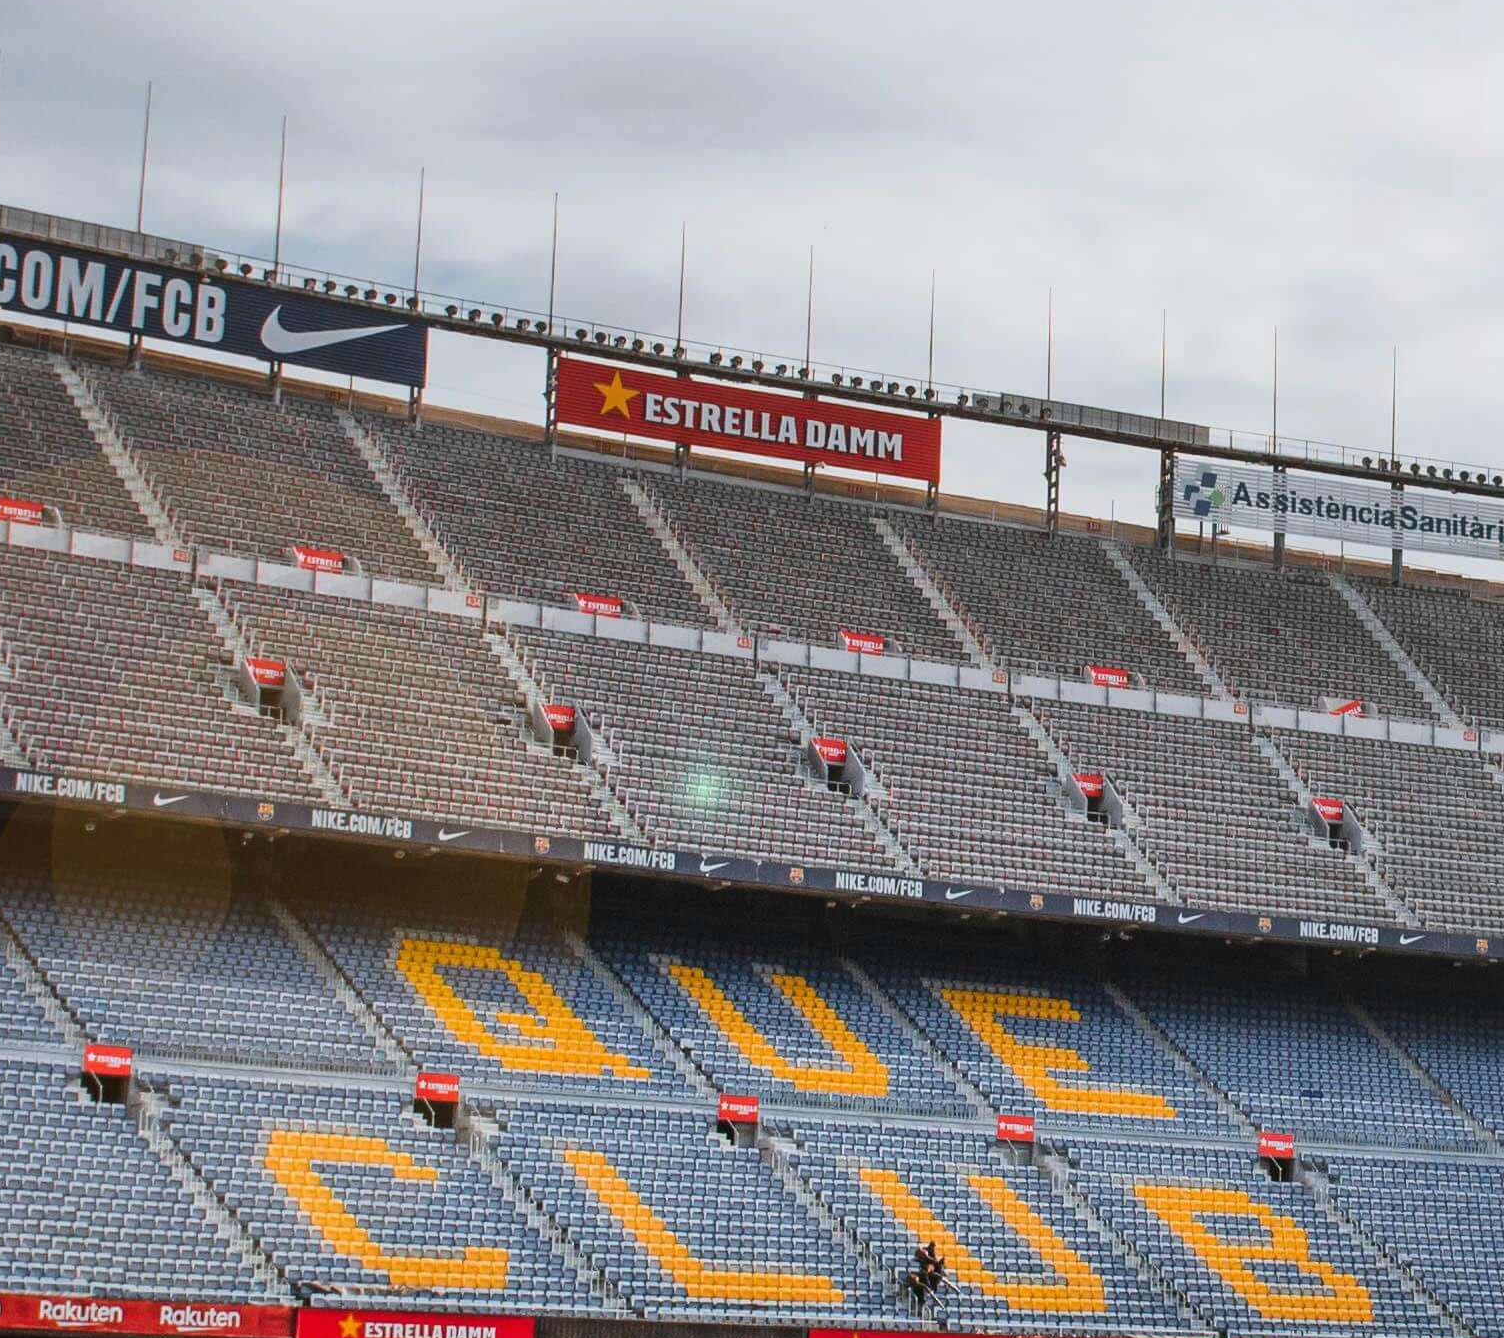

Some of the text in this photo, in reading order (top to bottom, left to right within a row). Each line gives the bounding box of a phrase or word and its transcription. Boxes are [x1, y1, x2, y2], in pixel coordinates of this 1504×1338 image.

[645, 393, 903, 461] ESTRELLA DAMM
[4, 507, 42, 519] ESTRELLA
[1232, 482, 1396, 528] Assistència
[16, 772, 125, 804] NIKE.COM/FCB
[312, 809, 412, 839] NIKE.COM/FCB
[583, 842, 675, 870] NIKE.COM/FCB
[835, 871, 923, 898] NIKE.COM/FCB
[1073, 898, 1156, 922] NIKE.COM/FCB
[1300, 921, 1379, 944] NIKE.COM/FCB
[396, 938, 1176, 1118] QUE
[263, 1130, 1375, 1322] CLUB
[39, 1300, 122, 1323] Rakuten
[160, 1306, 240, 1328] Rakuten
